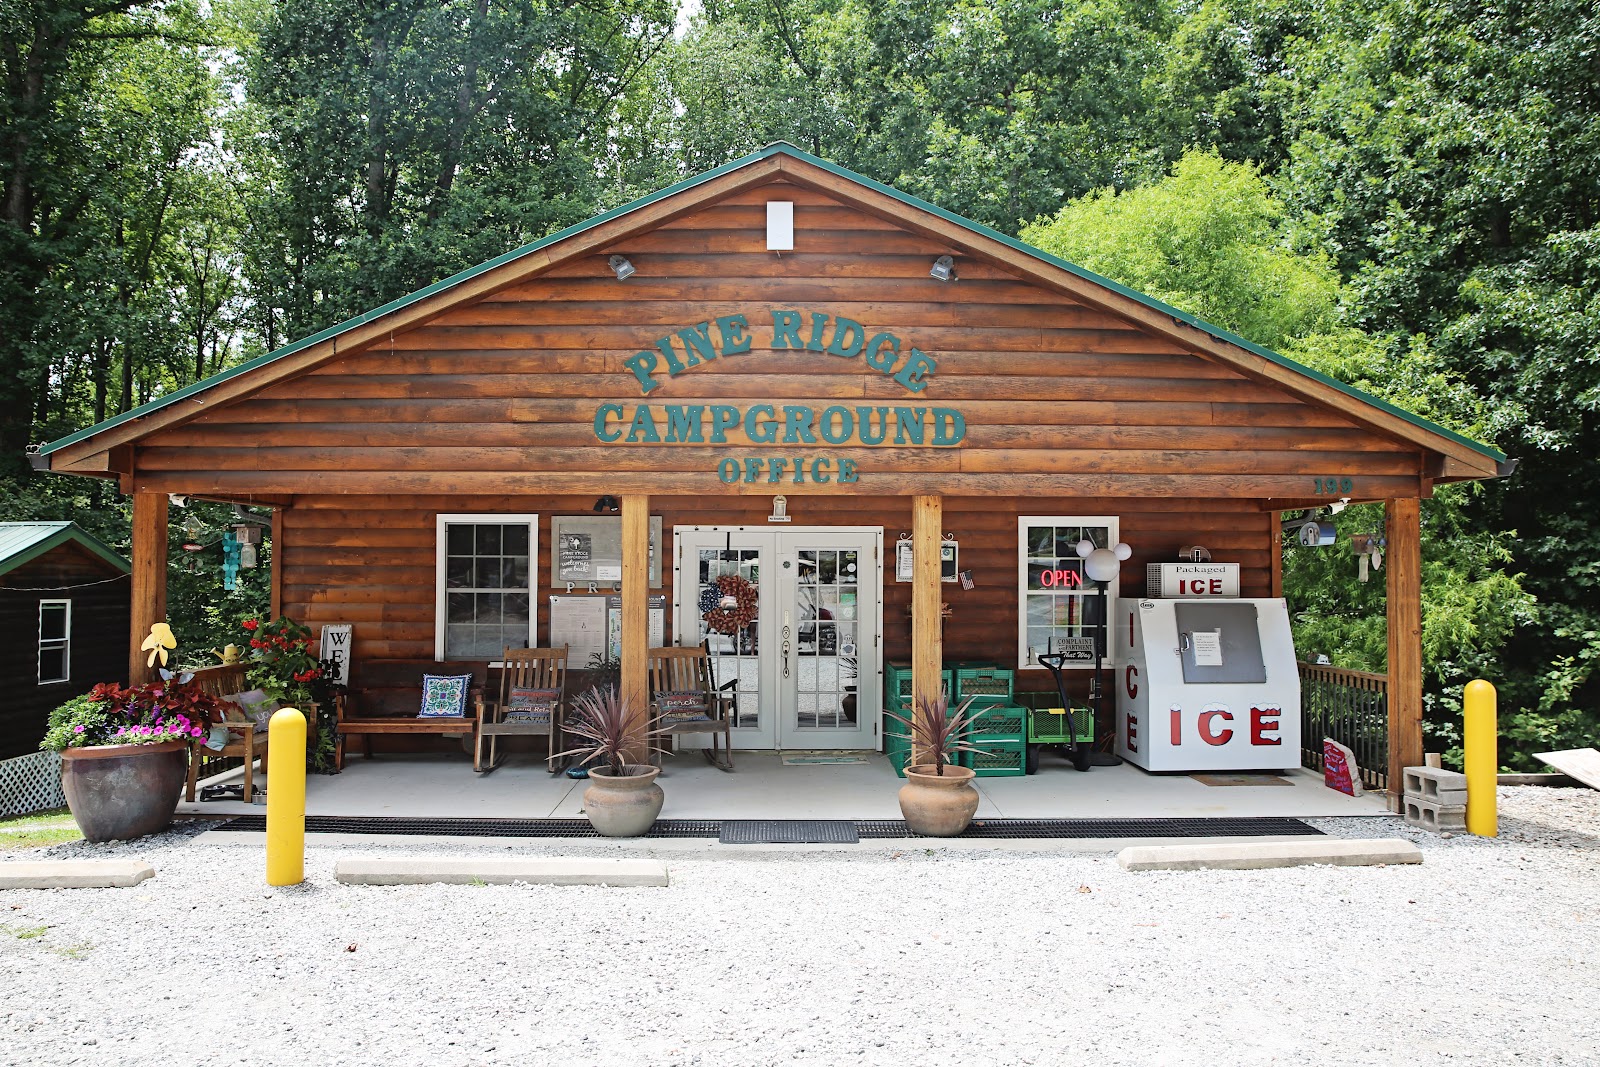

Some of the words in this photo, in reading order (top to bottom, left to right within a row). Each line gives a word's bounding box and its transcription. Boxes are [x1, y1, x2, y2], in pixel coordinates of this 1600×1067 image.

[624, 313, 752, 394] PINE
[770, 310, 937, 394] RIDGE
[593, 404, 967, 446] CAMPGROUND
[717, 457, 860, 484] OFFICE
[1314, 479, 1353, 494] 199
[1176, 566, 1226, 574] Packaged
[1041, 570, 1082, 587] OPEN
[1179, 578, 1223, 594] ICE
[1077, 651, 1092, 659] Way
[667, 698, 699, 707] porch
[1169, 702, 1282, 746] ICE
